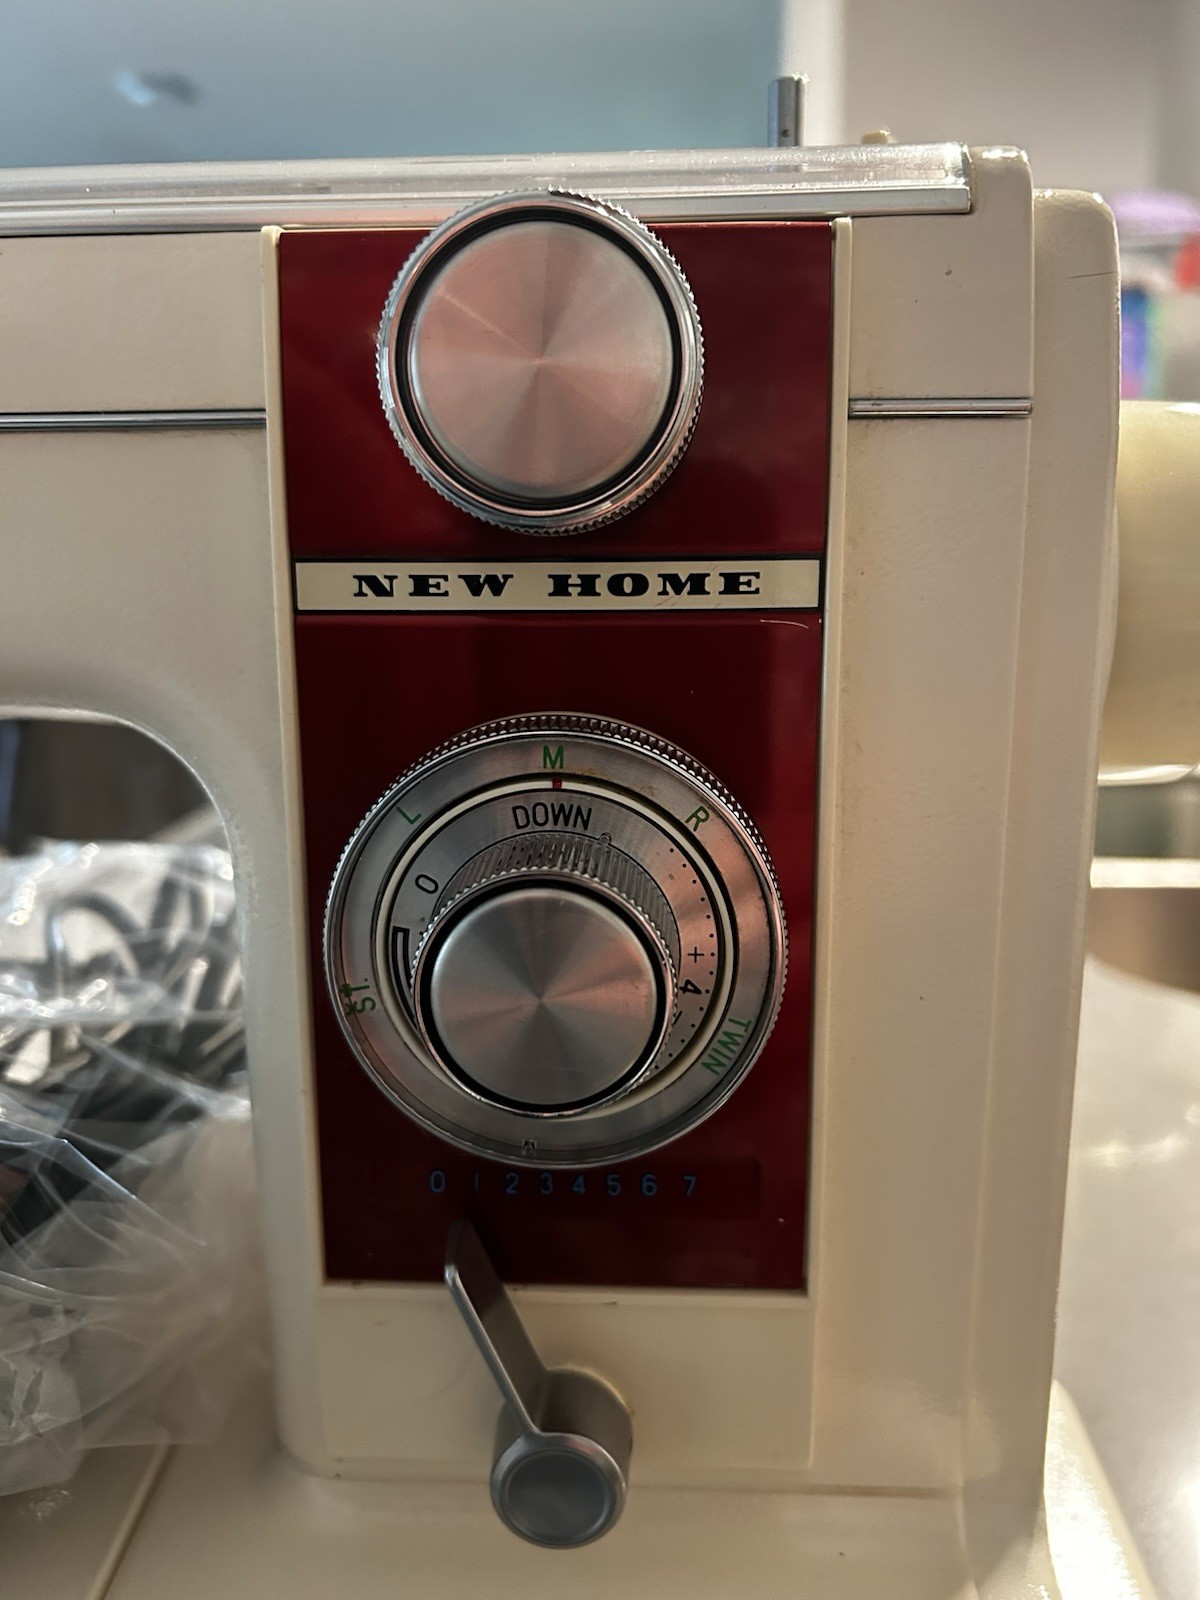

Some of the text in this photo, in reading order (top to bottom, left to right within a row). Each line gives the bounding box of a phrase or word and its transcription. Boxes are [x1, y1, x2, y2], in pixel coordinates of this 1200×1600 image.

[353, 571, 761, 598] NEW HOME
[543, 745, 564, 769] M
[396, 806, 422, 825] L
[512, 802, 592, 830] DOWN
[685, 806, 710, 832] R
[679, 979, 702, 995] 4
[701, 1018, 752, 1076] TWIN
[429, 1170, 446, 1194] 0
[505, 1172, 520, 1195] 2
[539, 1172, 554, 1195] 3
[572, 1174, 587, 1195] 4
[606, 1174, 622, 1197] 5
[641, 1173, 658, 1197] 6
[682, 1175, 697, 1197] 7
